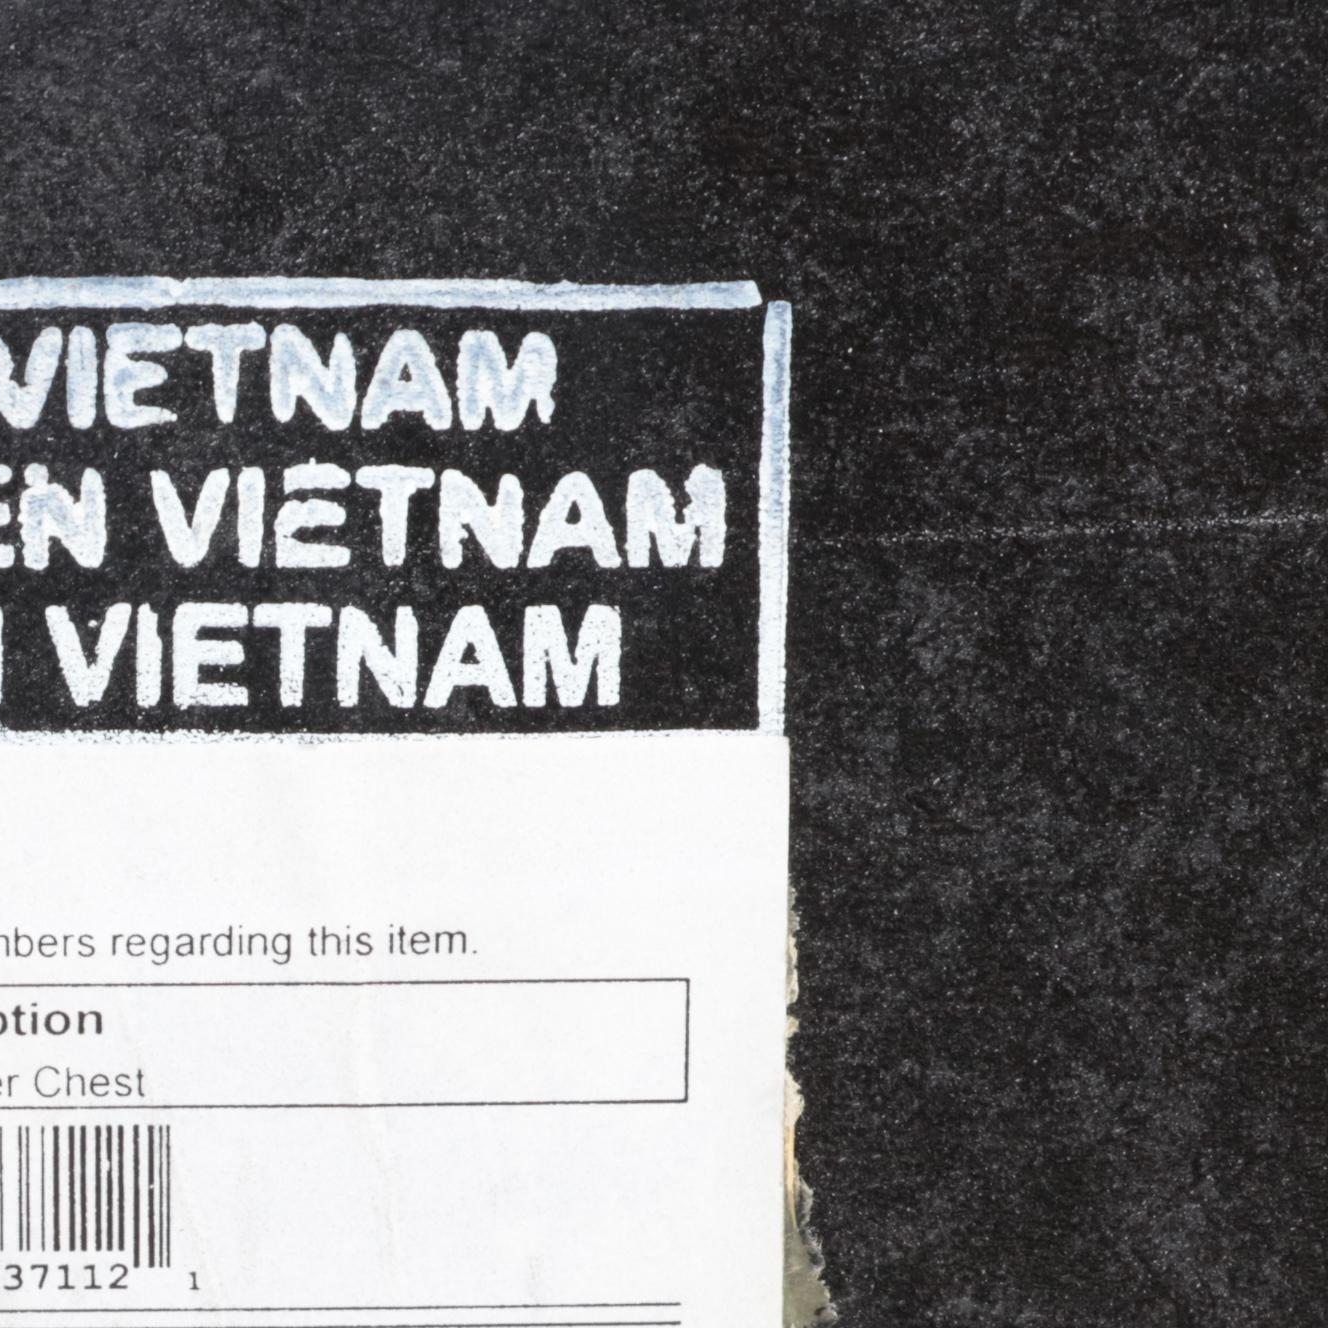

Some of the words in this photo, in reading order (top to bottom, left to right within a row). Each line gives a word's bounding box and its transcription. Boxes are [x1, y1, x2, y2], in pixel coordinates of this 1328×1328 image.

[151, 462, 729, 570] VIETNAM
[47, 603, 624, 709] VIETNAM
[112, 926, 291, 965] regarding
[309, 926, 373, 956] this
[389, 924, 476, 955] item.
[35, 1066, 144, 1097] Chest
[4, 1266, 128, 1290] 37112
[190, 1272, 199, 1290] 1
